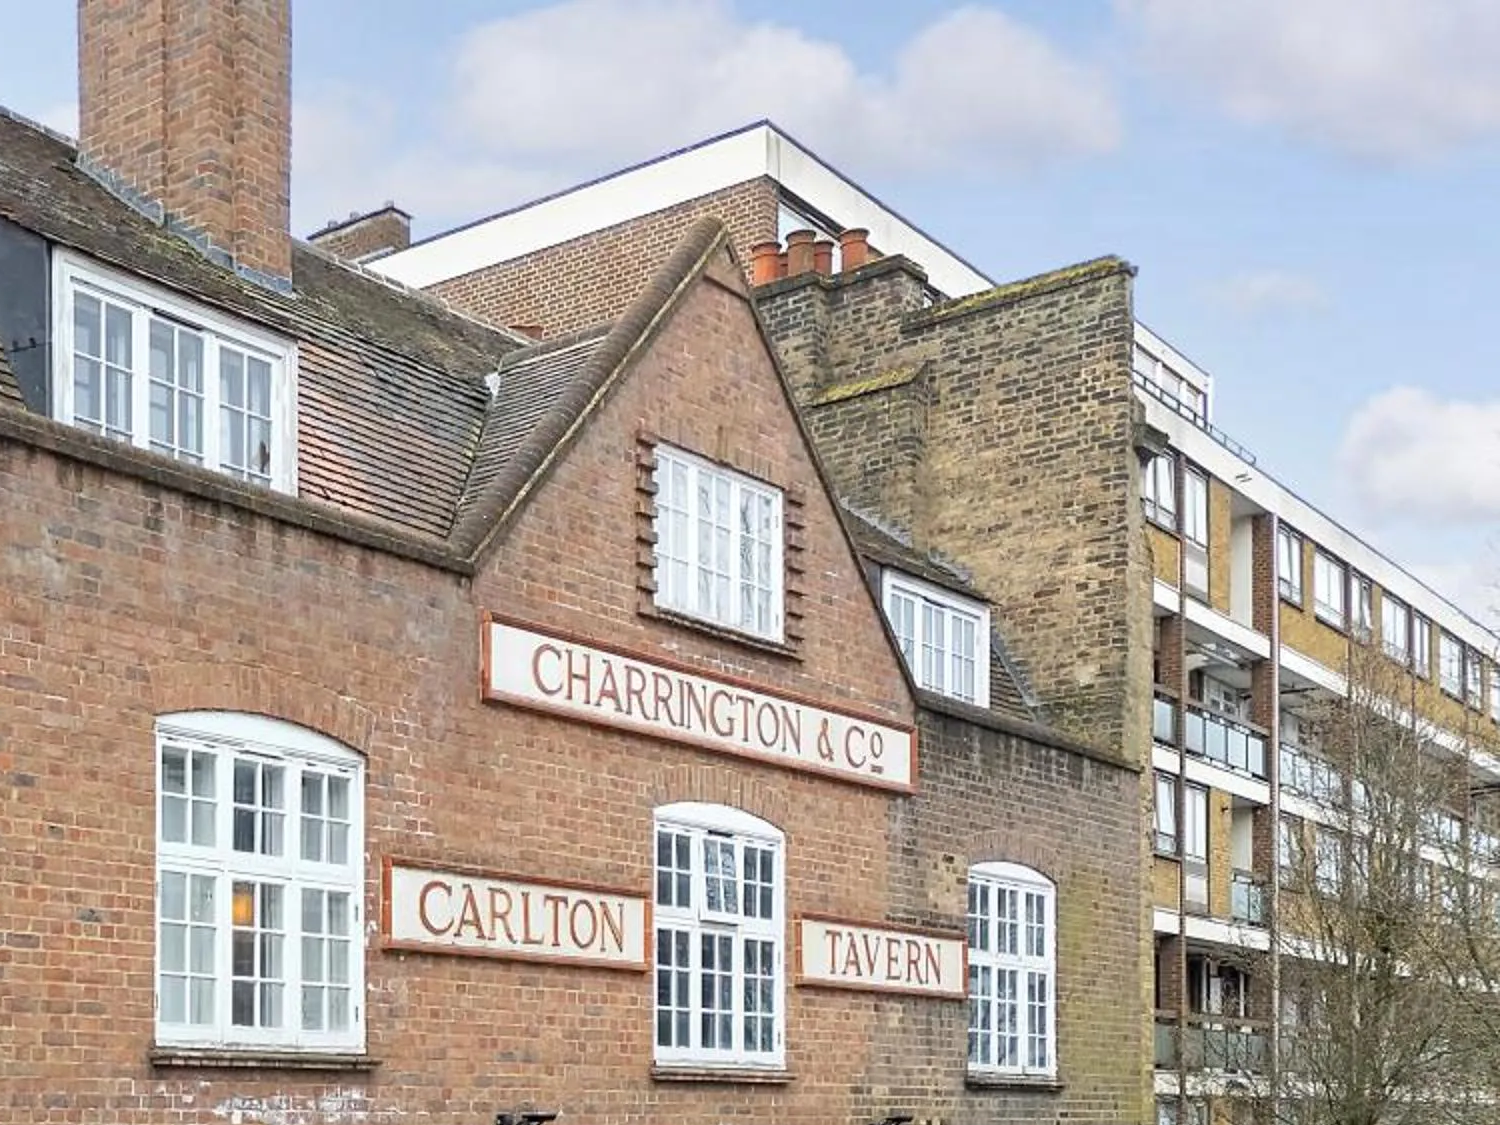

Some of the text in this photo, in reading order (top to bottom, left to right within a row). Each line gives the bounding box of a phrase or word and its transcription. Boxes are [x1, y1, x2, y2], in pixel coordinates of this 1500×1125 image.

[531, 642, 801, 755] CHARRINGTON
[816, 718, 835, 763] &
[418, 879, 626, 954] CARLTON
[823, 929, 943, 985] TAVERN
